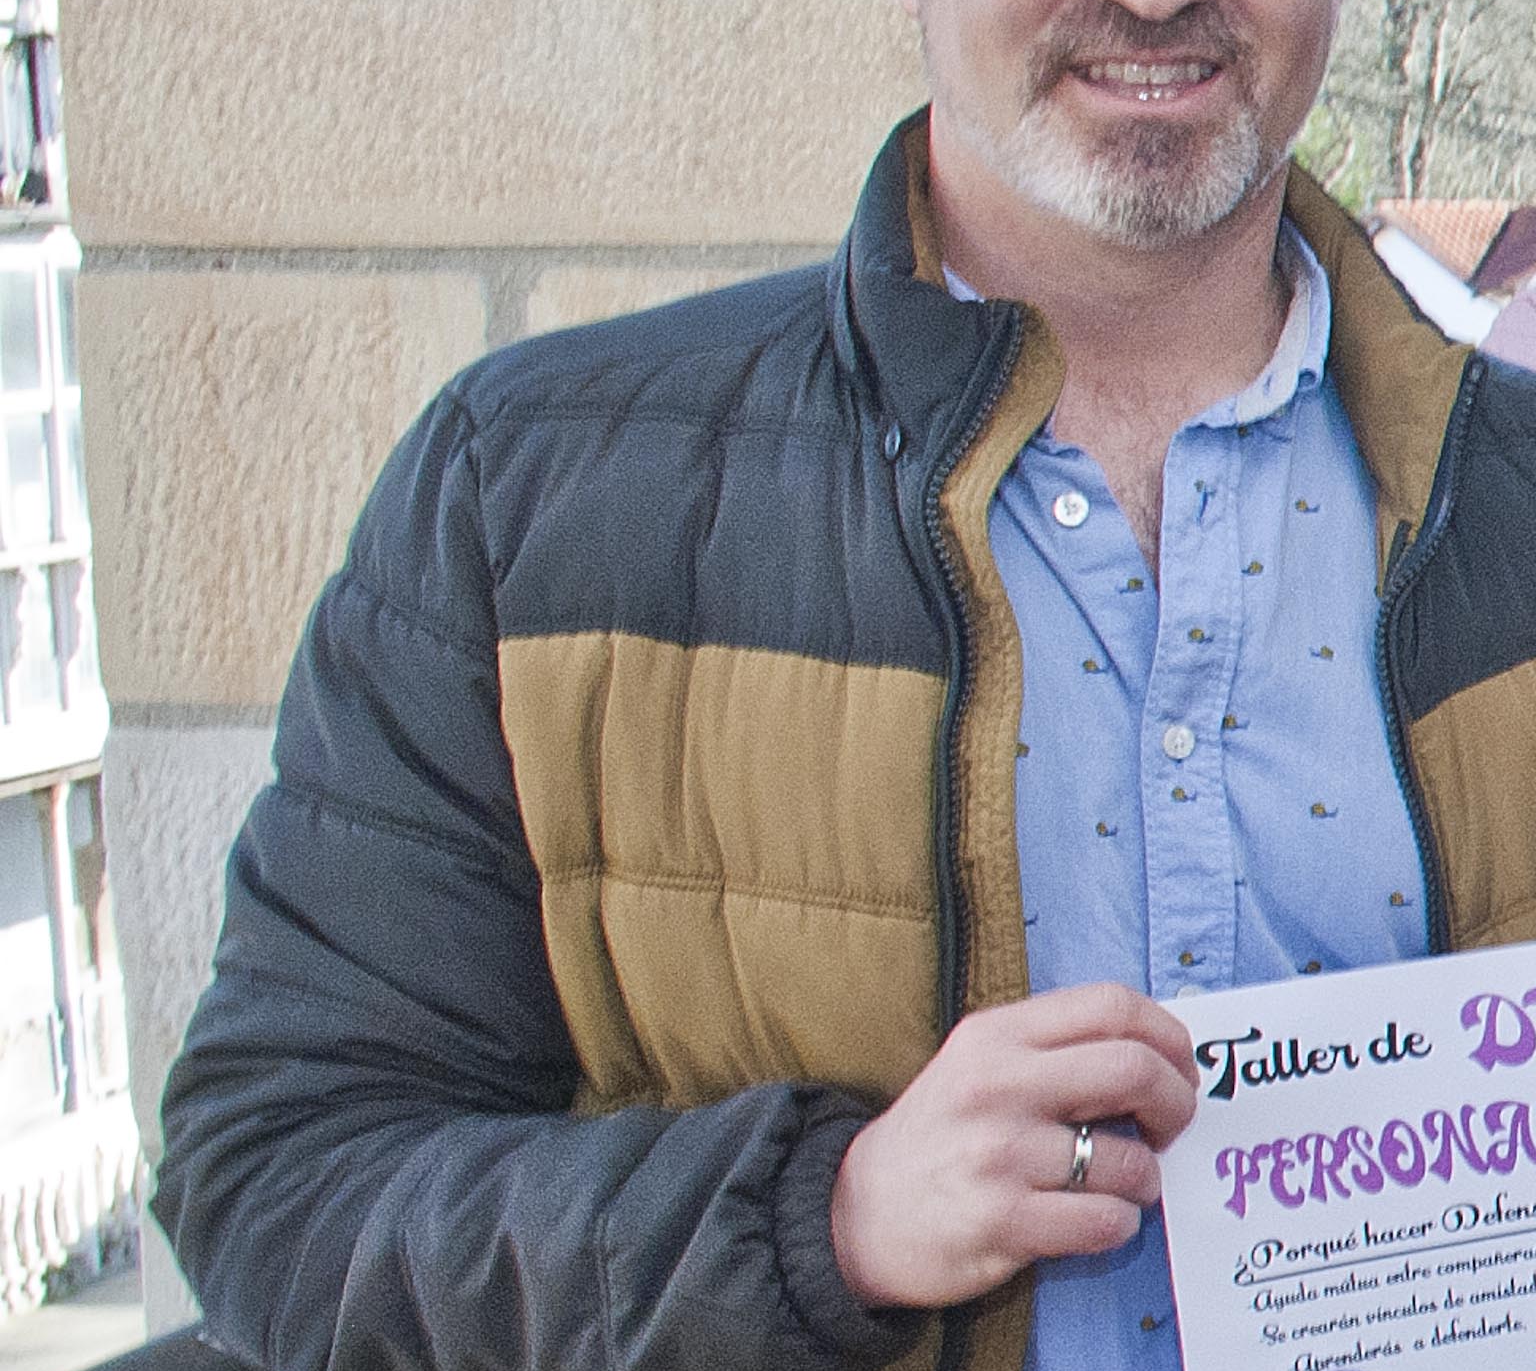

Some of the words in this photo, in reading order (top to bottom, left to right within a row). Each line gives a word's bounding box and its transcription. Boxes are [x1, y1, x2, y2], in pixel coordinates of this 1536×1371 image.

[1195, 1028, 1358, 1099] Taller
[1368, 1021, 1431, 1063] de
[1363, 1221, 1432, 1246] hacer
